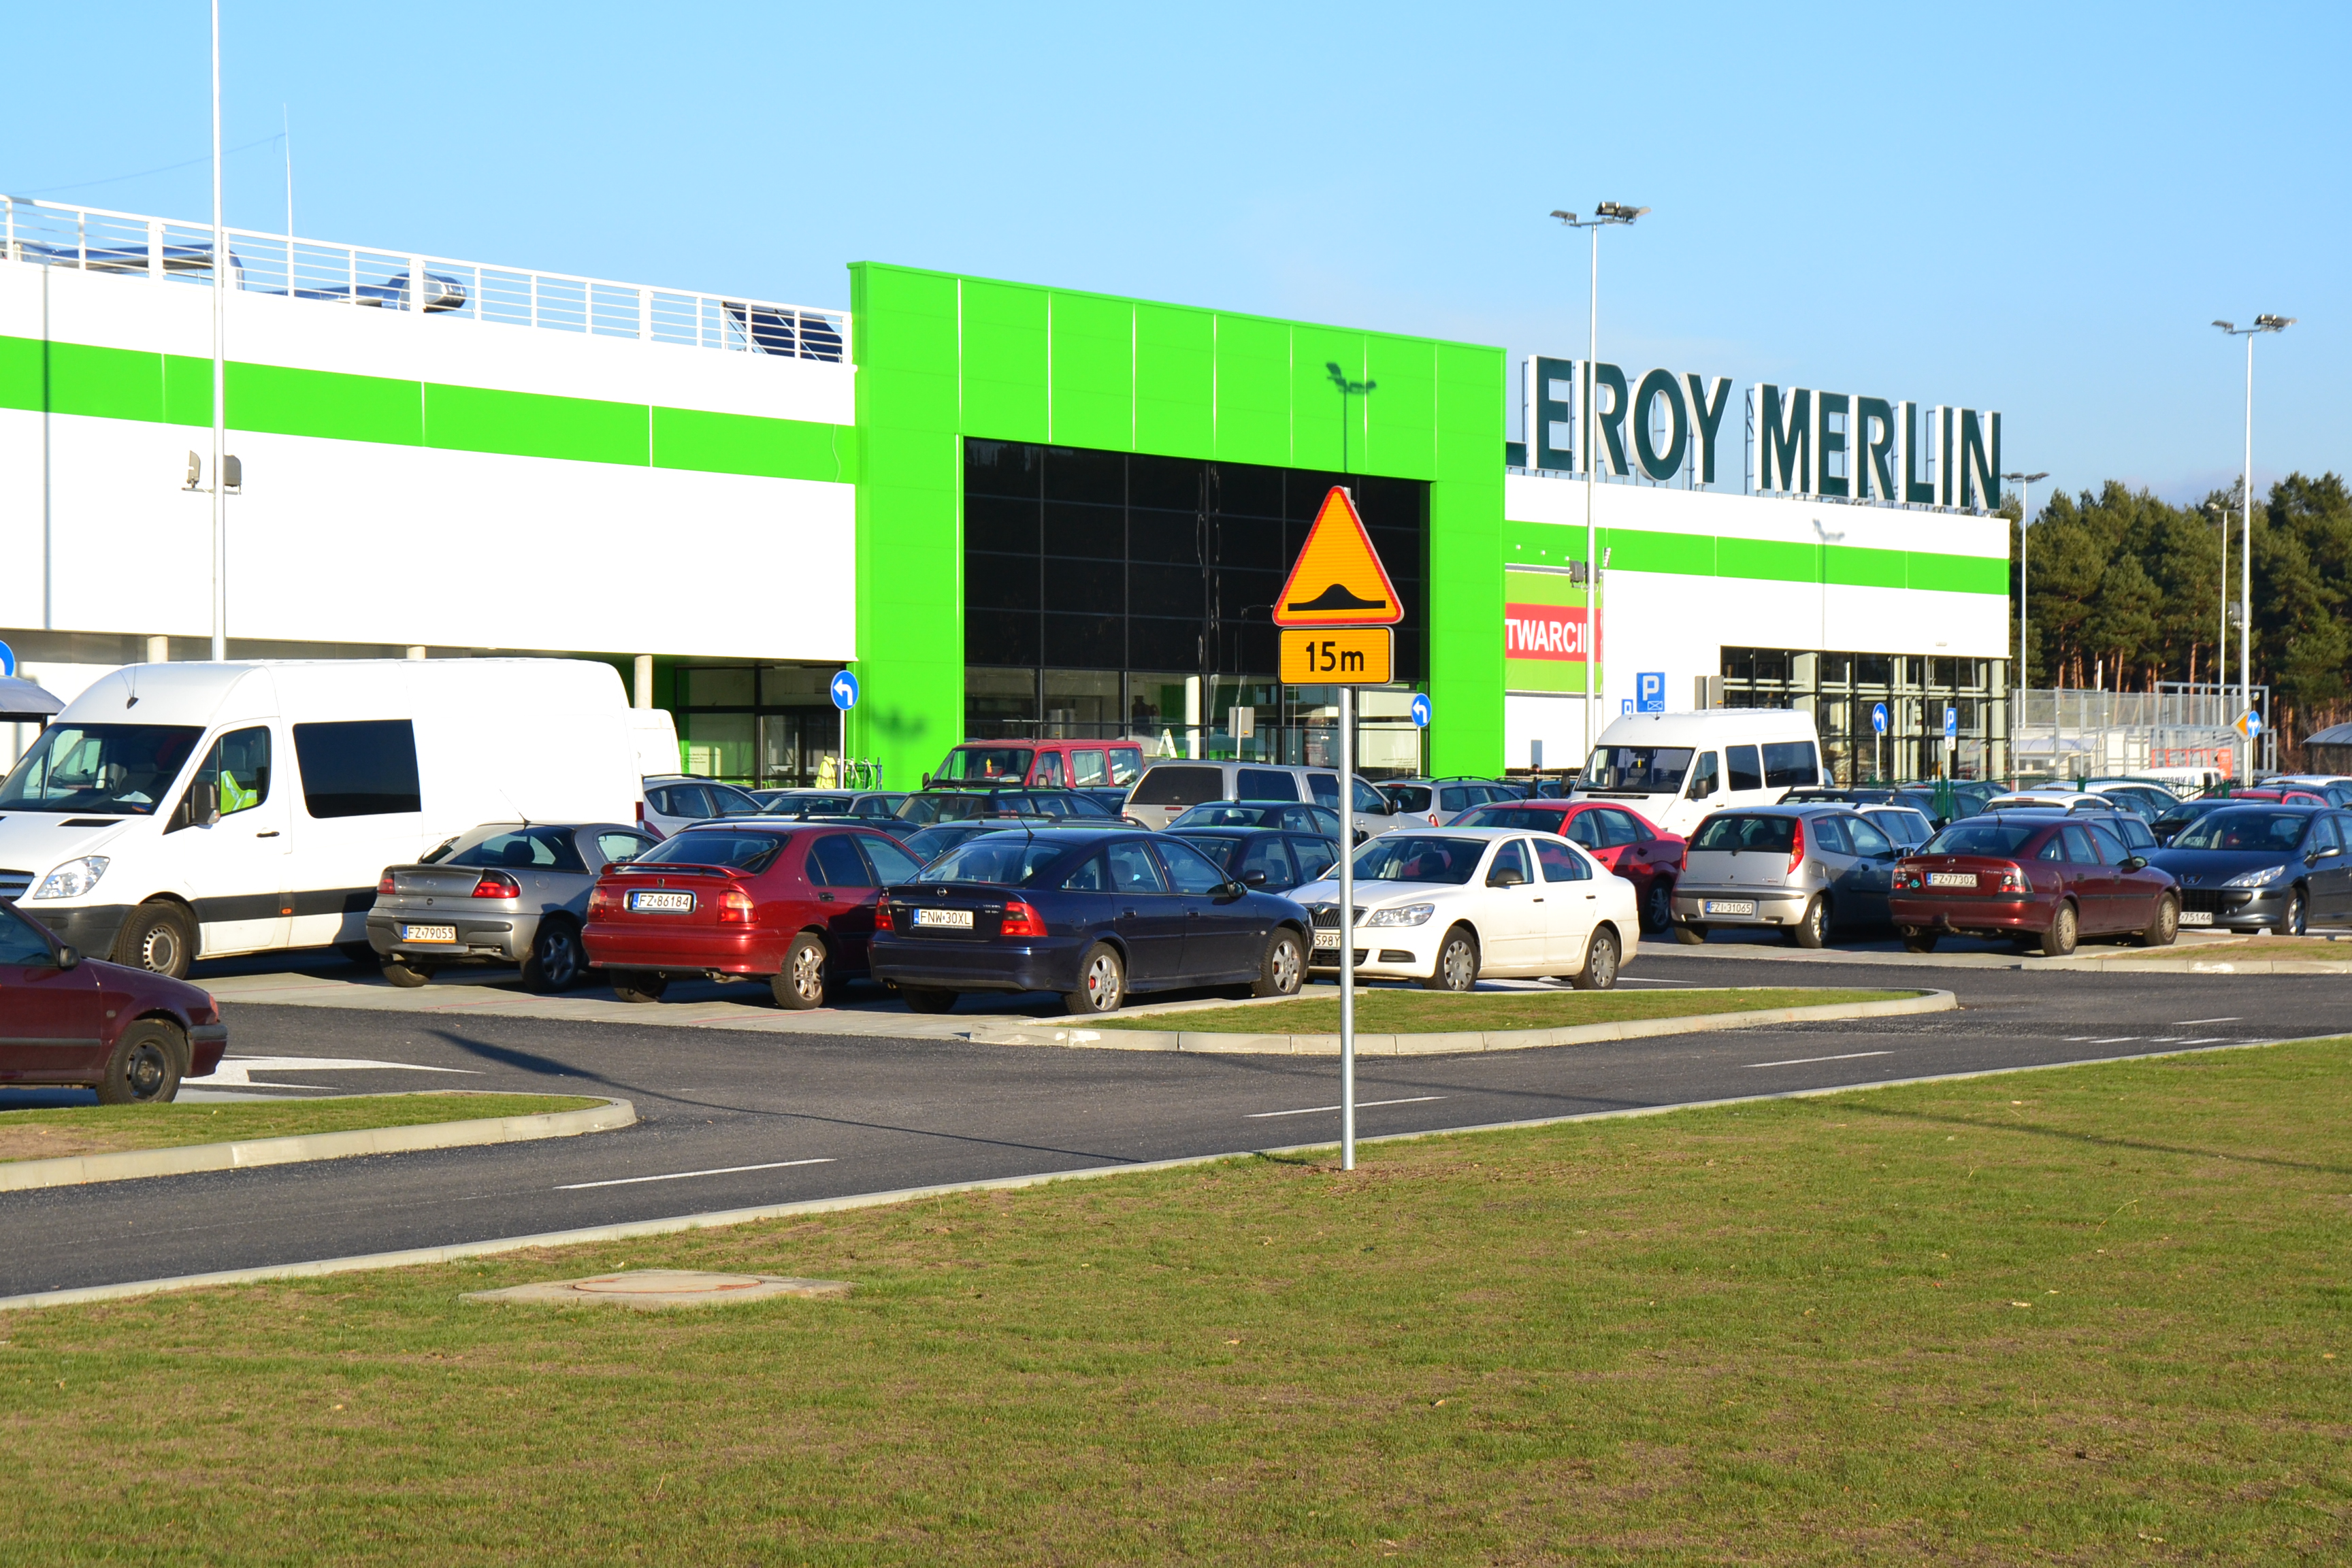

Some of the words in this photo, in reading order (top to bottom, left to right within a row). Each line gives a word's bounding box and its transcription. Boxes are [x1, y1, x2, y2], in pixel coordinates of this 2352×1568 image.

[1505, 354, 1733, 484] EROY
[1753, 382, 2002, 511] MERLIN
[1505, 619, 1587, 653] TWARCI
[1642, 675, 1660, 701] P
[1947, 710, 1955, 728] P
